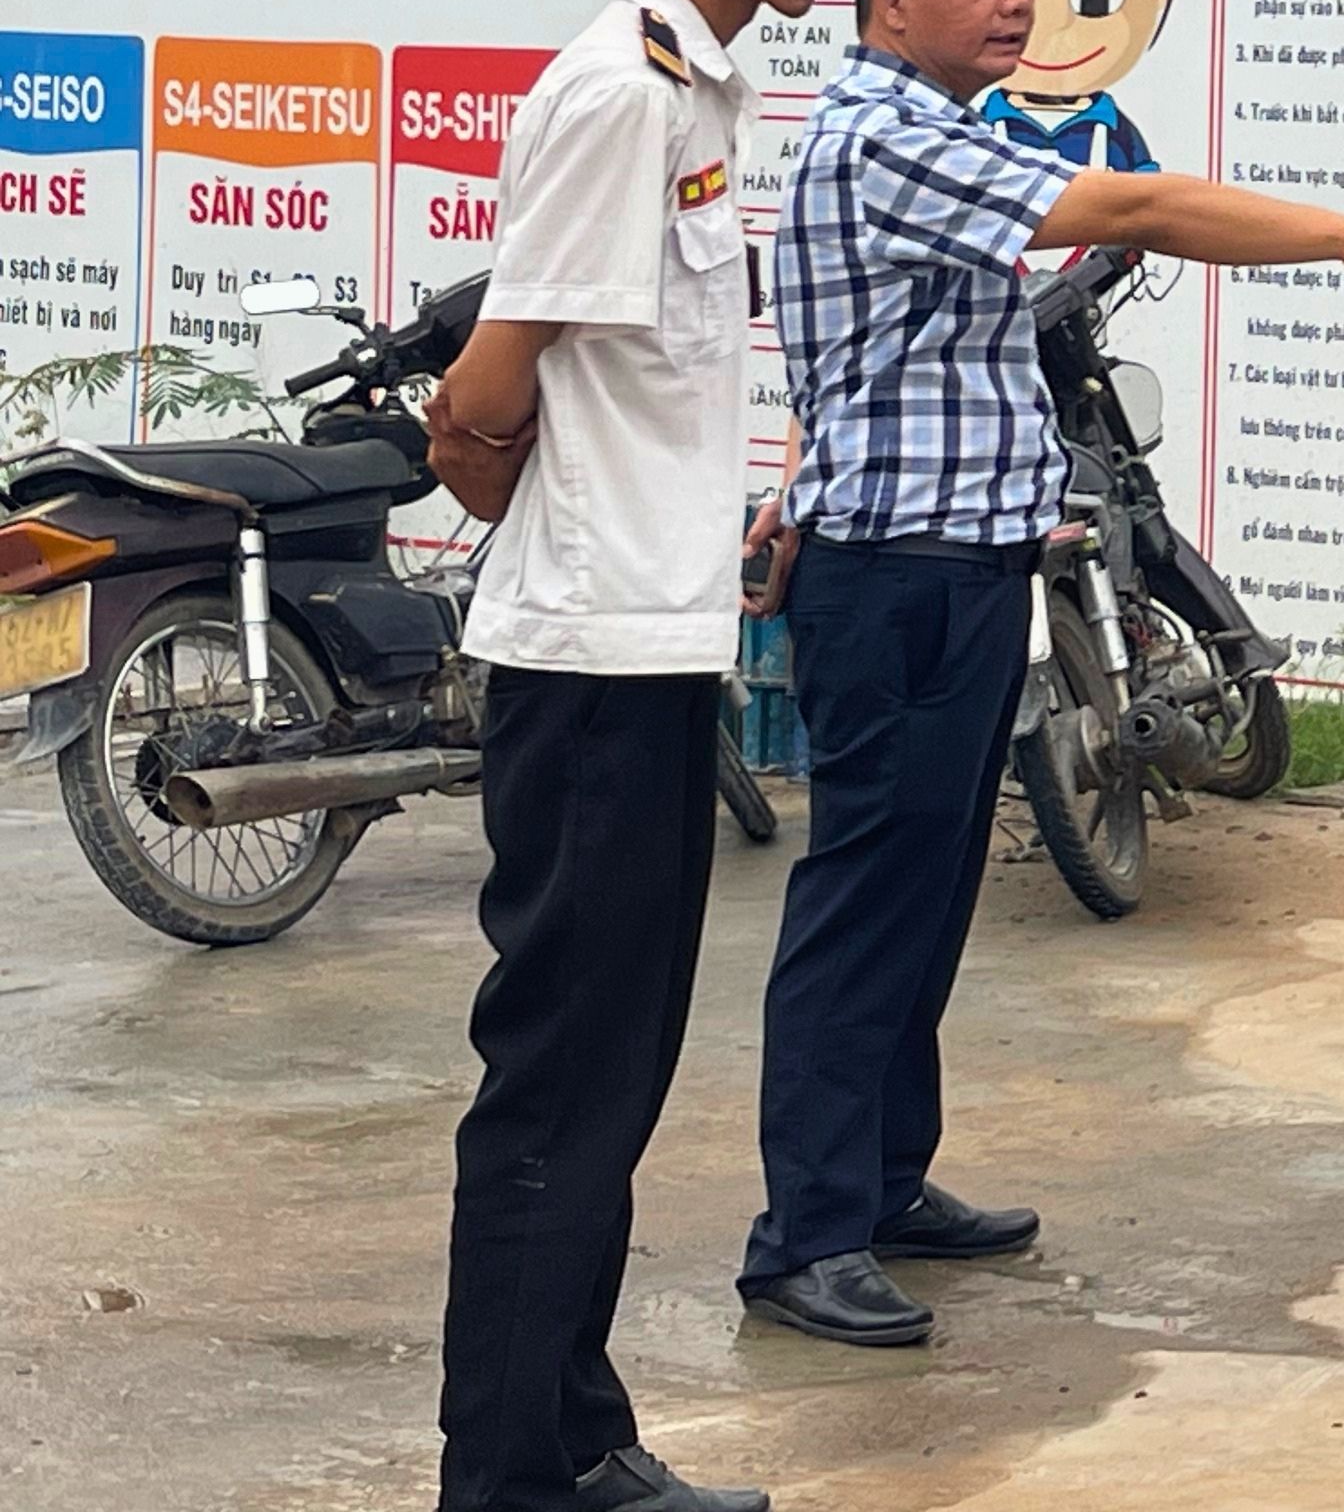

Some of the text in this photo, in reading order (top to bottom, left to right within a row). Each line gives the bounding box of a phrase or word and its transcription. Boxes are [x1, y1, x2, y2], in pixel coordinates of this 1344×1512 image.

[760, 21, 830, 44] DÂY AN
[769, 54, 820, 77] TOÀN
[0, 72, 105, 122] -SEISO
[163, 78, 373, 137] S4-SEIKETSU
[49, 168, 86, 216] SẼ
[189, 176, 254, 227] SĂN
[266, 180, 329, 232] SÓC
[11, 255, 118, 290] sạch sẽ máy
[171, 264, 205, 295] Duy
[334, 276, 358, 303] S3
[36, 300, 117, 332] bị và nơi
[170, 310, 261, 349] hàng ngày
